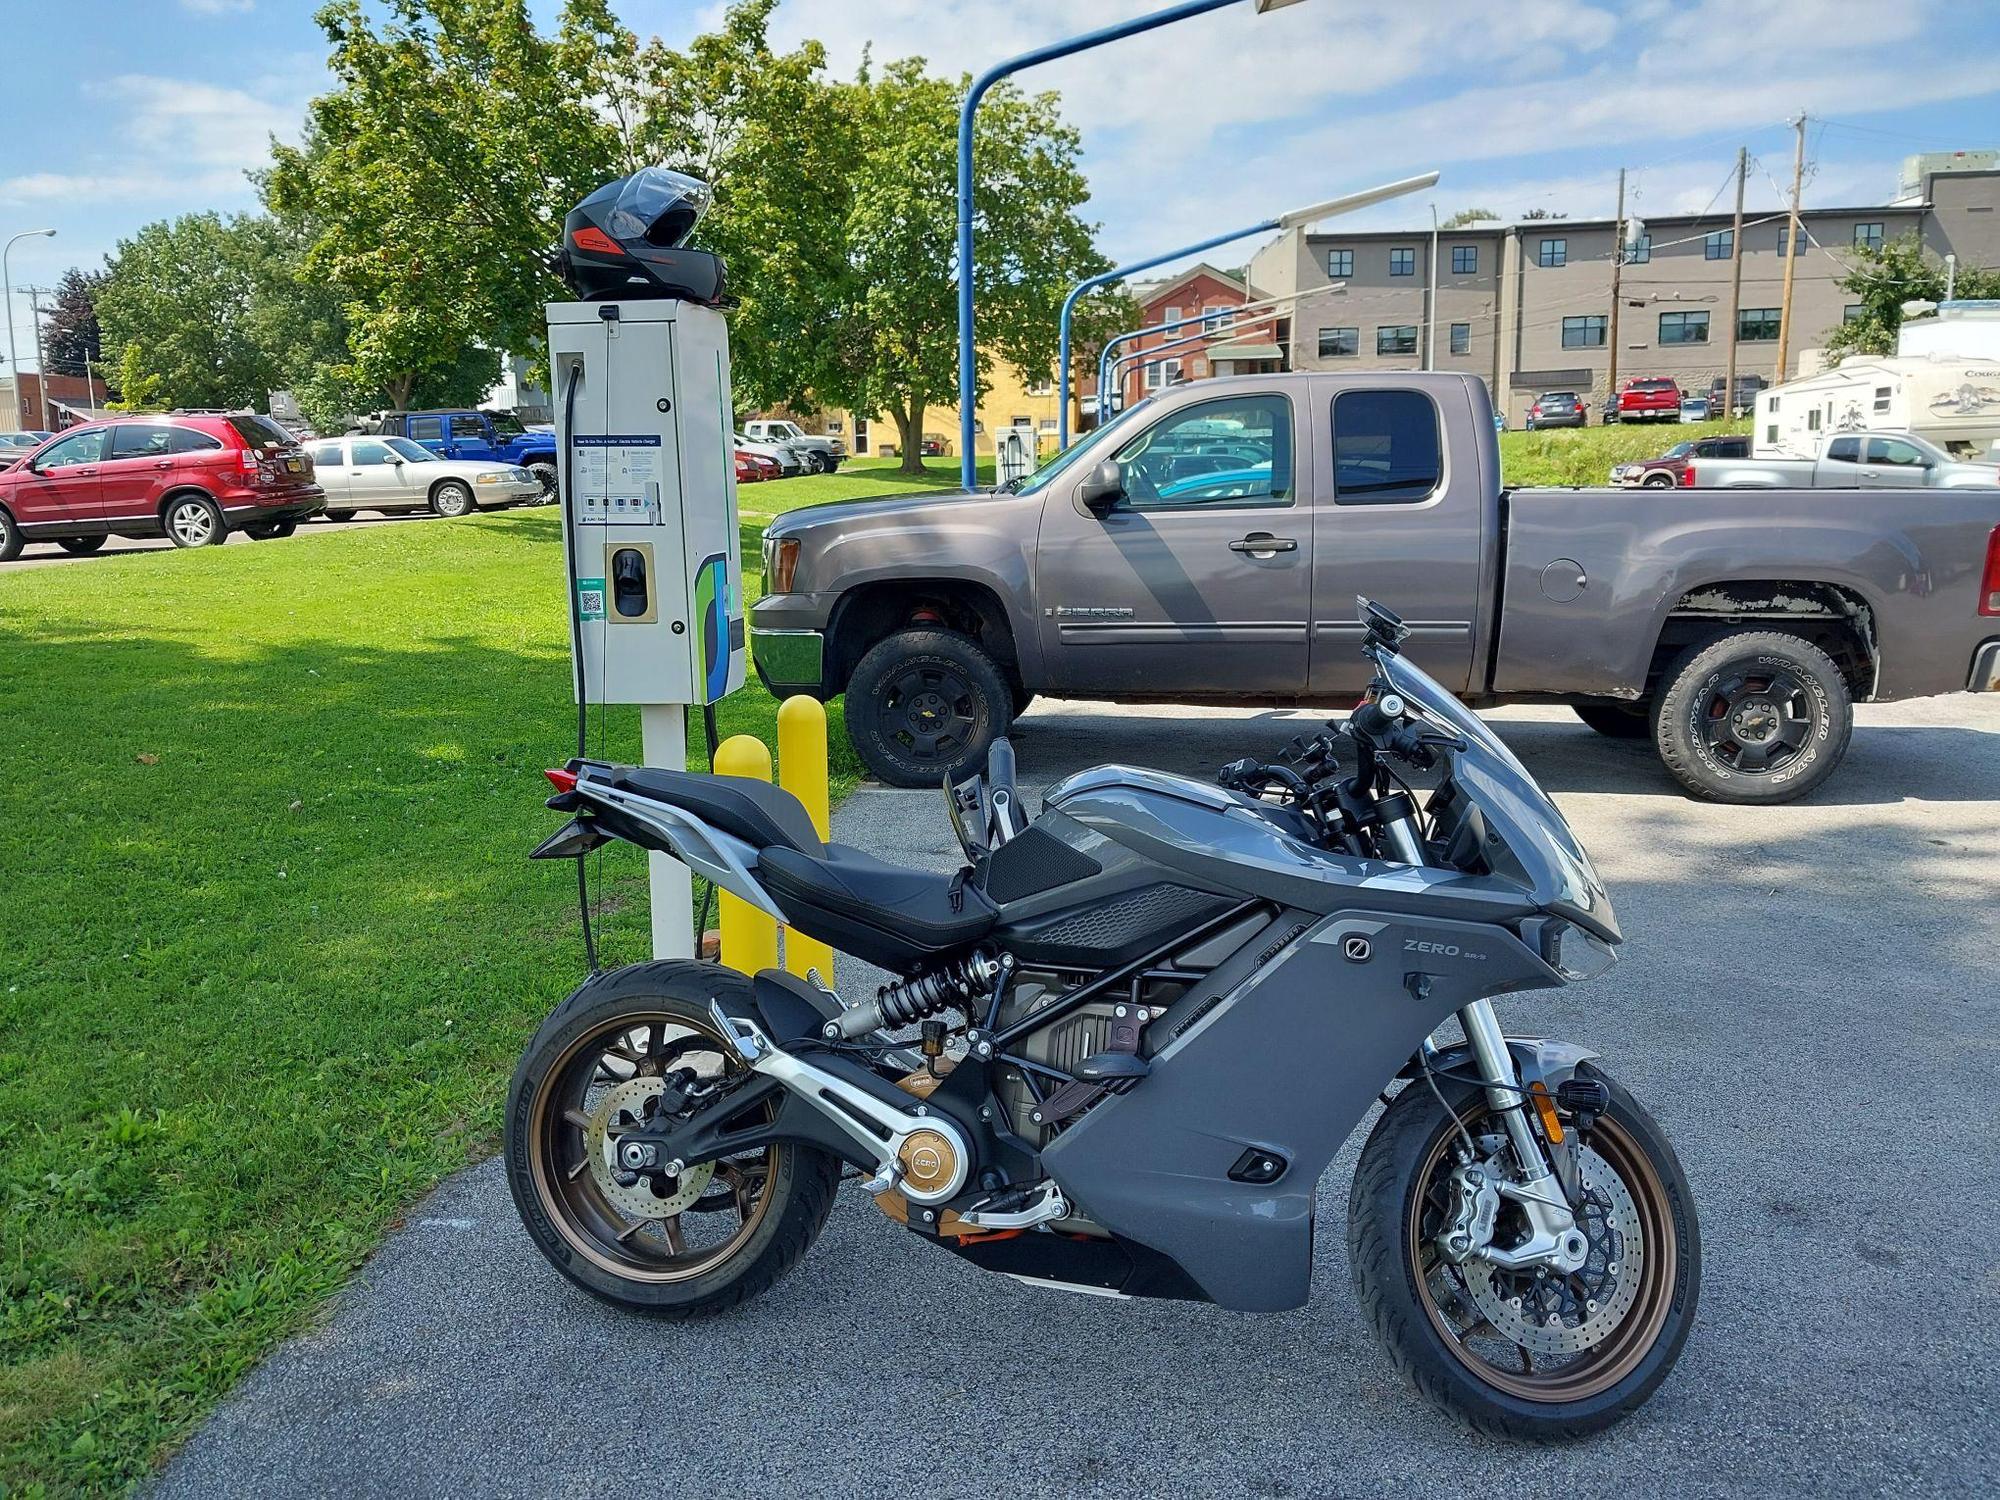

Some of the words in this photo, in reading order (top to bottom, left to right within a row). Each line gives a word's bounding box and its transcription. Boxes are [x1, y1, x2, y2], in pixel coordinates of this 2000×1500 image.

[1057, 606, 1133, 616] SIERRA
[1758, 656, 1831, 741] WRANGLER
[1689, 673, 1732, 780] GOODYEAR
[1403, 939, 1460, 956] ZERO
[916, 1159, 937, 1168] ZERO
